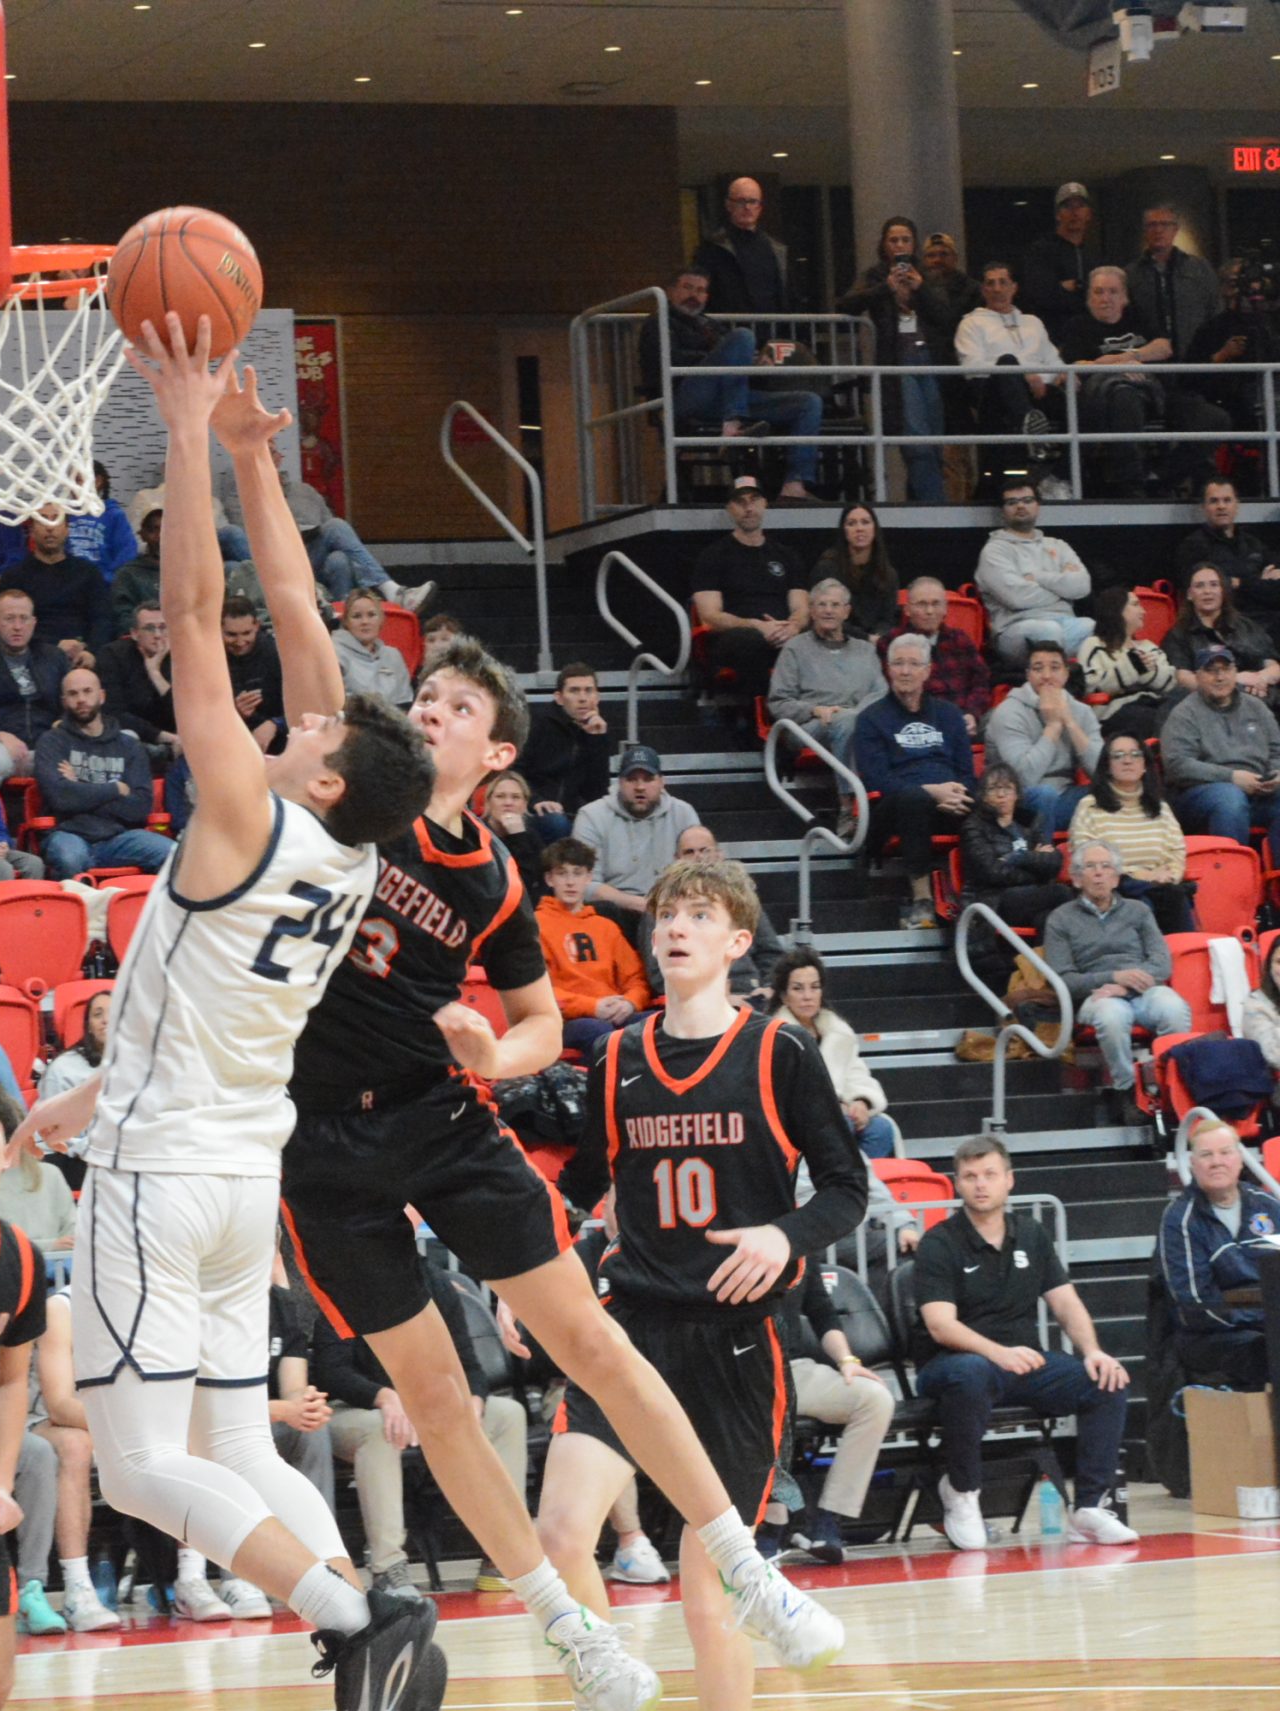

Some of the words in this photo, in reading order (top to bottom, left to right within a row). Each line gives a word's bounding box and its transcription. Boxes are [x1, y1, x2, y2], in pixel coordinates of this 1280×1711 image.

[1233, 147, 1262, 171] EXIT
[375, 857, 468, 948] GEFIELD
[249, 879, 364, 987] 24
[625, 1112, 745, 1149] RIDGEFIELD
[653, 1156, 718, 1229] 10
[1012, 1249, 1030, 1269] S
